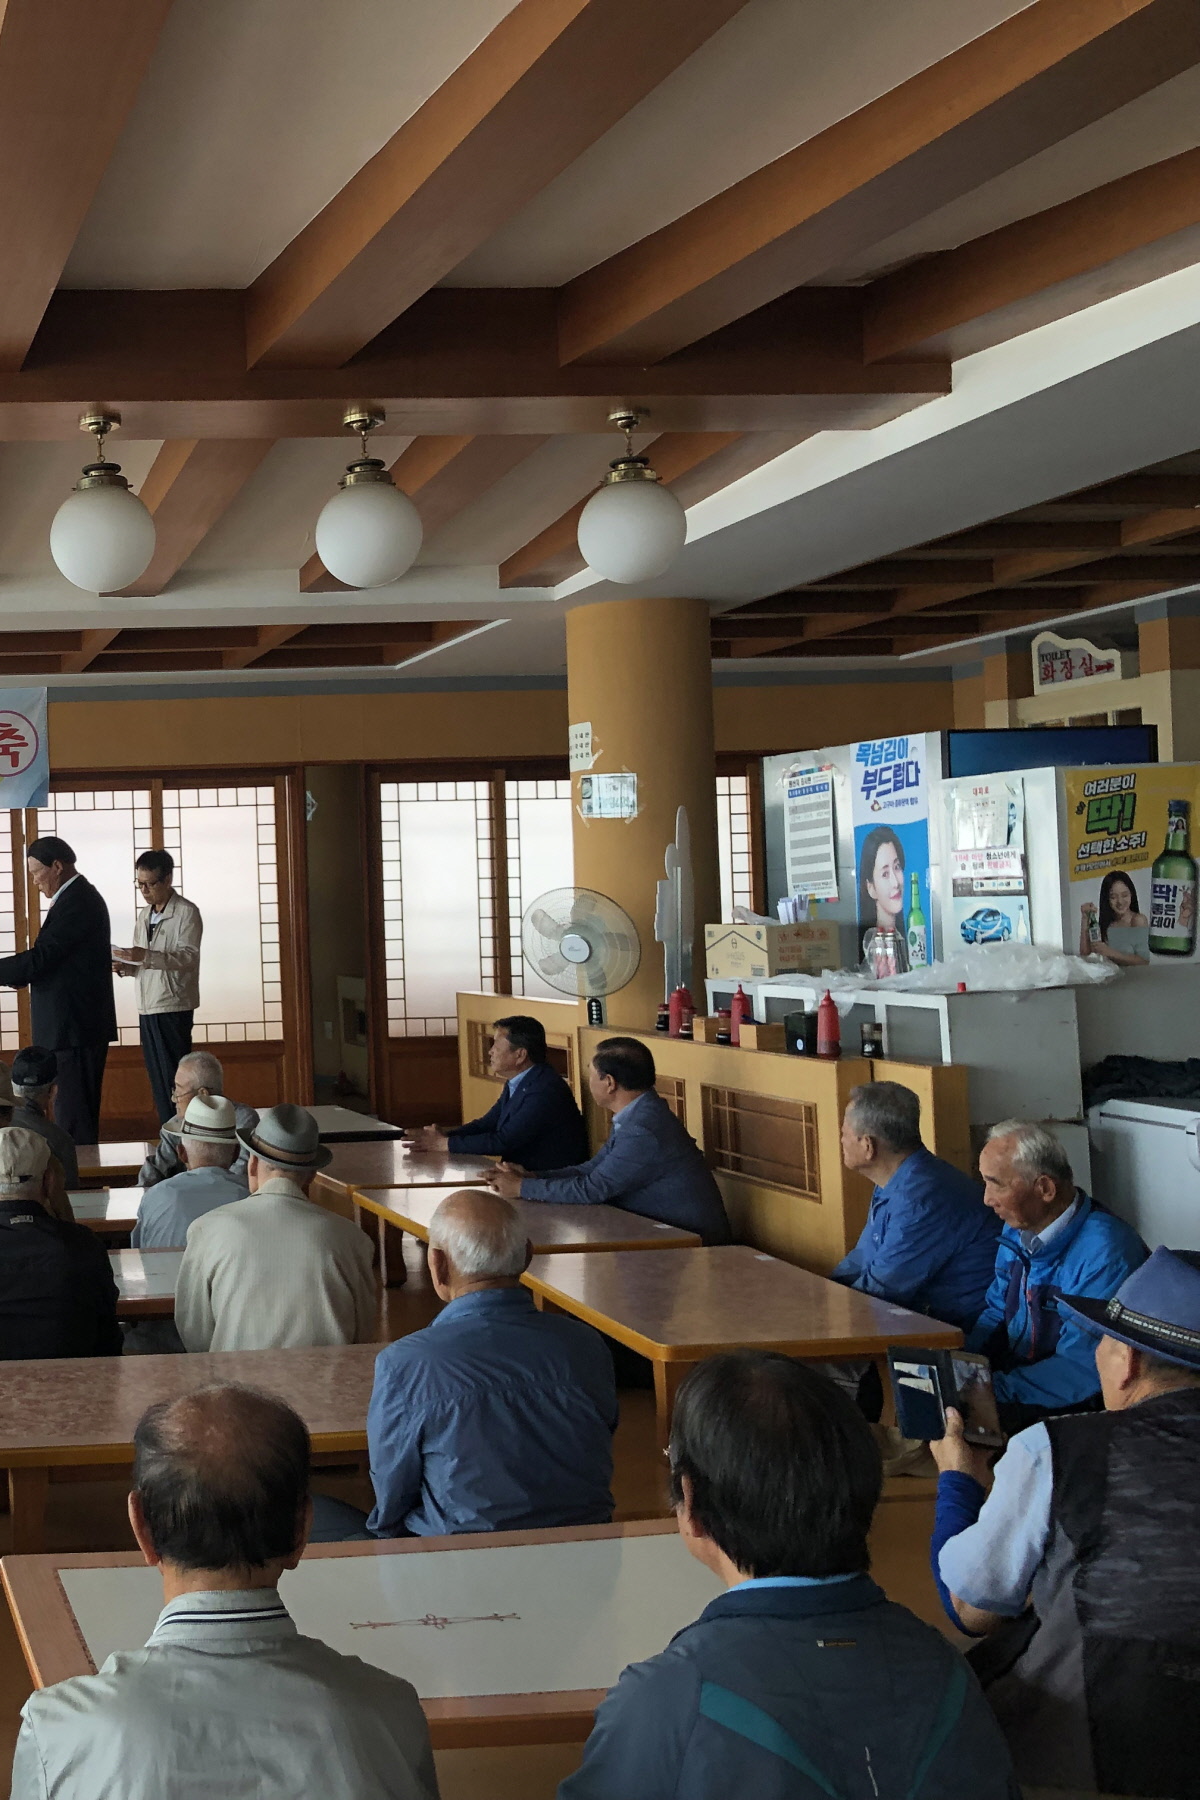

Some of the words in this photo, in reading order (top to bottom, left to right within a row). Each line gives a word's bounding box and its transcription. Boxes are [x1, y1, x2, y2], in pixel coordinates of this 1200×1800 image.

[1041, 650, 1071, 662] TOILET
[856, 737, 909, 767] 목넘김이
[861, 761, 921, 800] 부드럽다
[1084, 773, 1136, 796] 여러분이
[1086, 793, 1136, 836] 딱!
[986, 850, 1016, 860] 청소년에게
[1153, 883, 1178, 903] 딱!
[1152, 903, 1176, 916] 좋은
[1151, 916, 1175, 929] 데이
